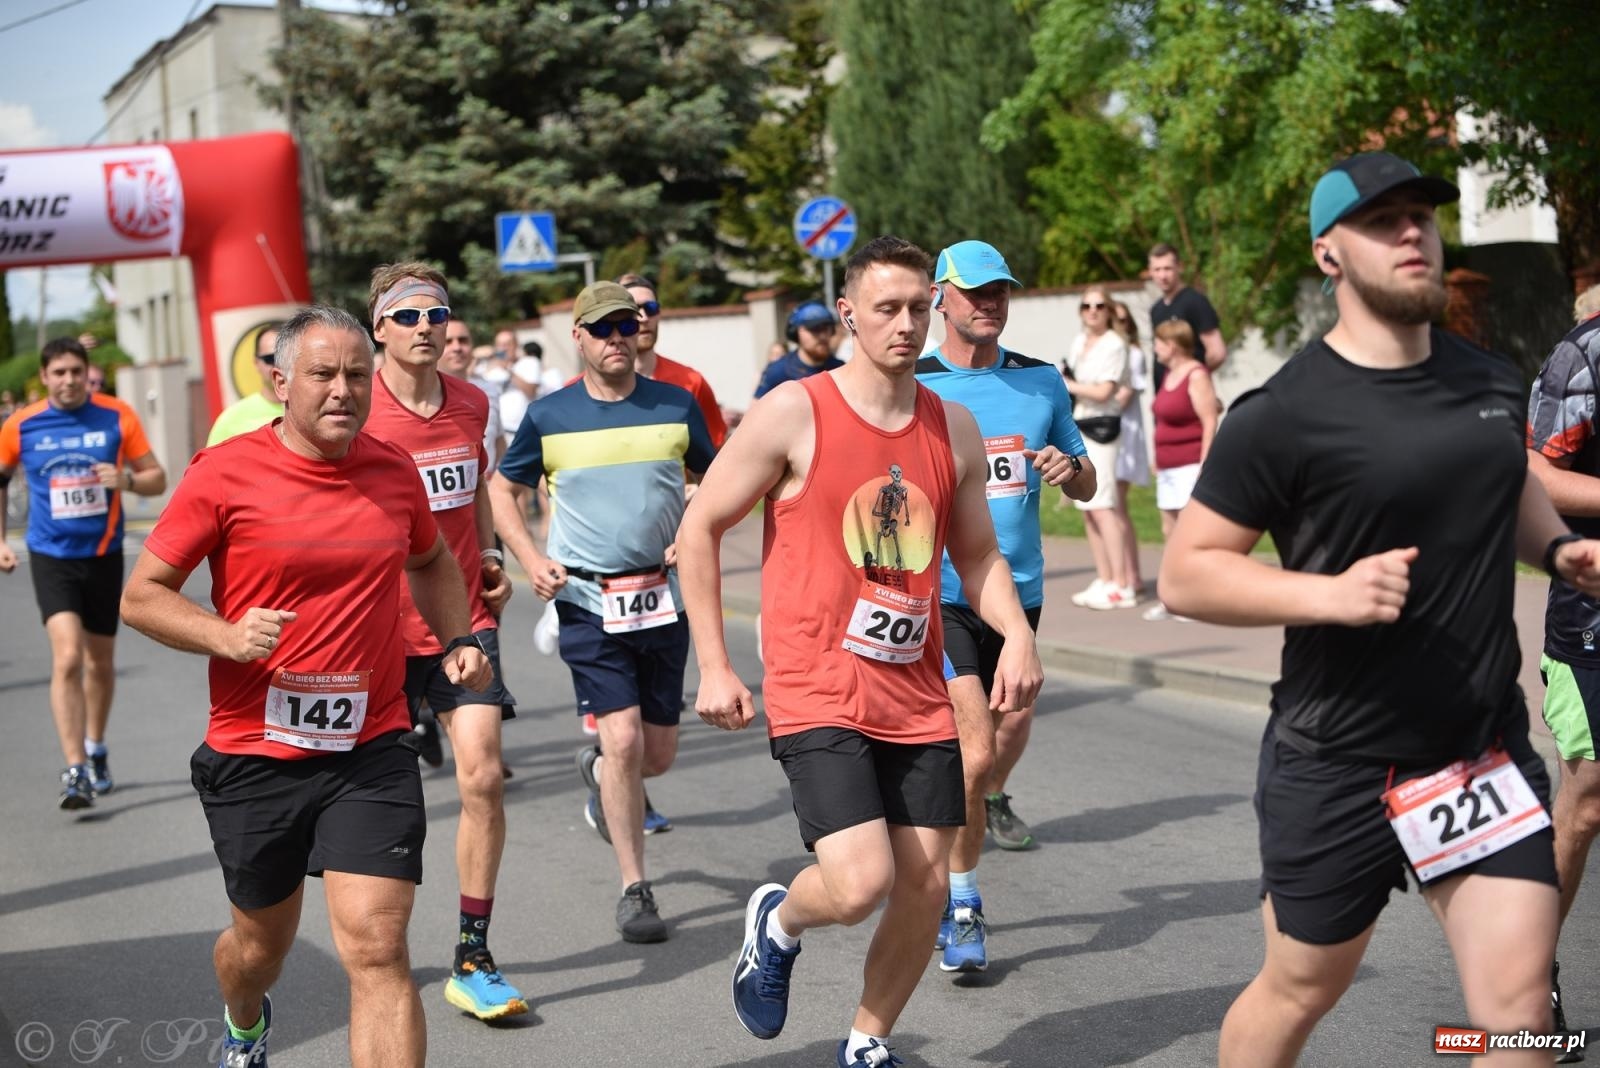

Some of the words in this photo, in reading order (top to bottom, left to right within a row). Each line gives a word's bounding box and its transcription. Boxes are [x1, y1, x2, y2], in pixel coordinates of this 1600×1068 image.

[427, 465, 466, 494] 161
[986, 456, 1012, 482] 6
[62, 488, 96, 505] 165
[616, 591, 659, 617] 140
[875, 587, 889, 597] XVI
[889, 592, 907, 602] BIEG
[865, 610, 928, 645] 204
[281, 672, 294, 681] XVI
[295, 675, 315, 683] BIEG
[315, 675, 331, 683] BEZ
[331, 674, 360, 683] GRANIC
[287, 696, 353, 730] 142
[1430, 781, 1509, 844] 221
